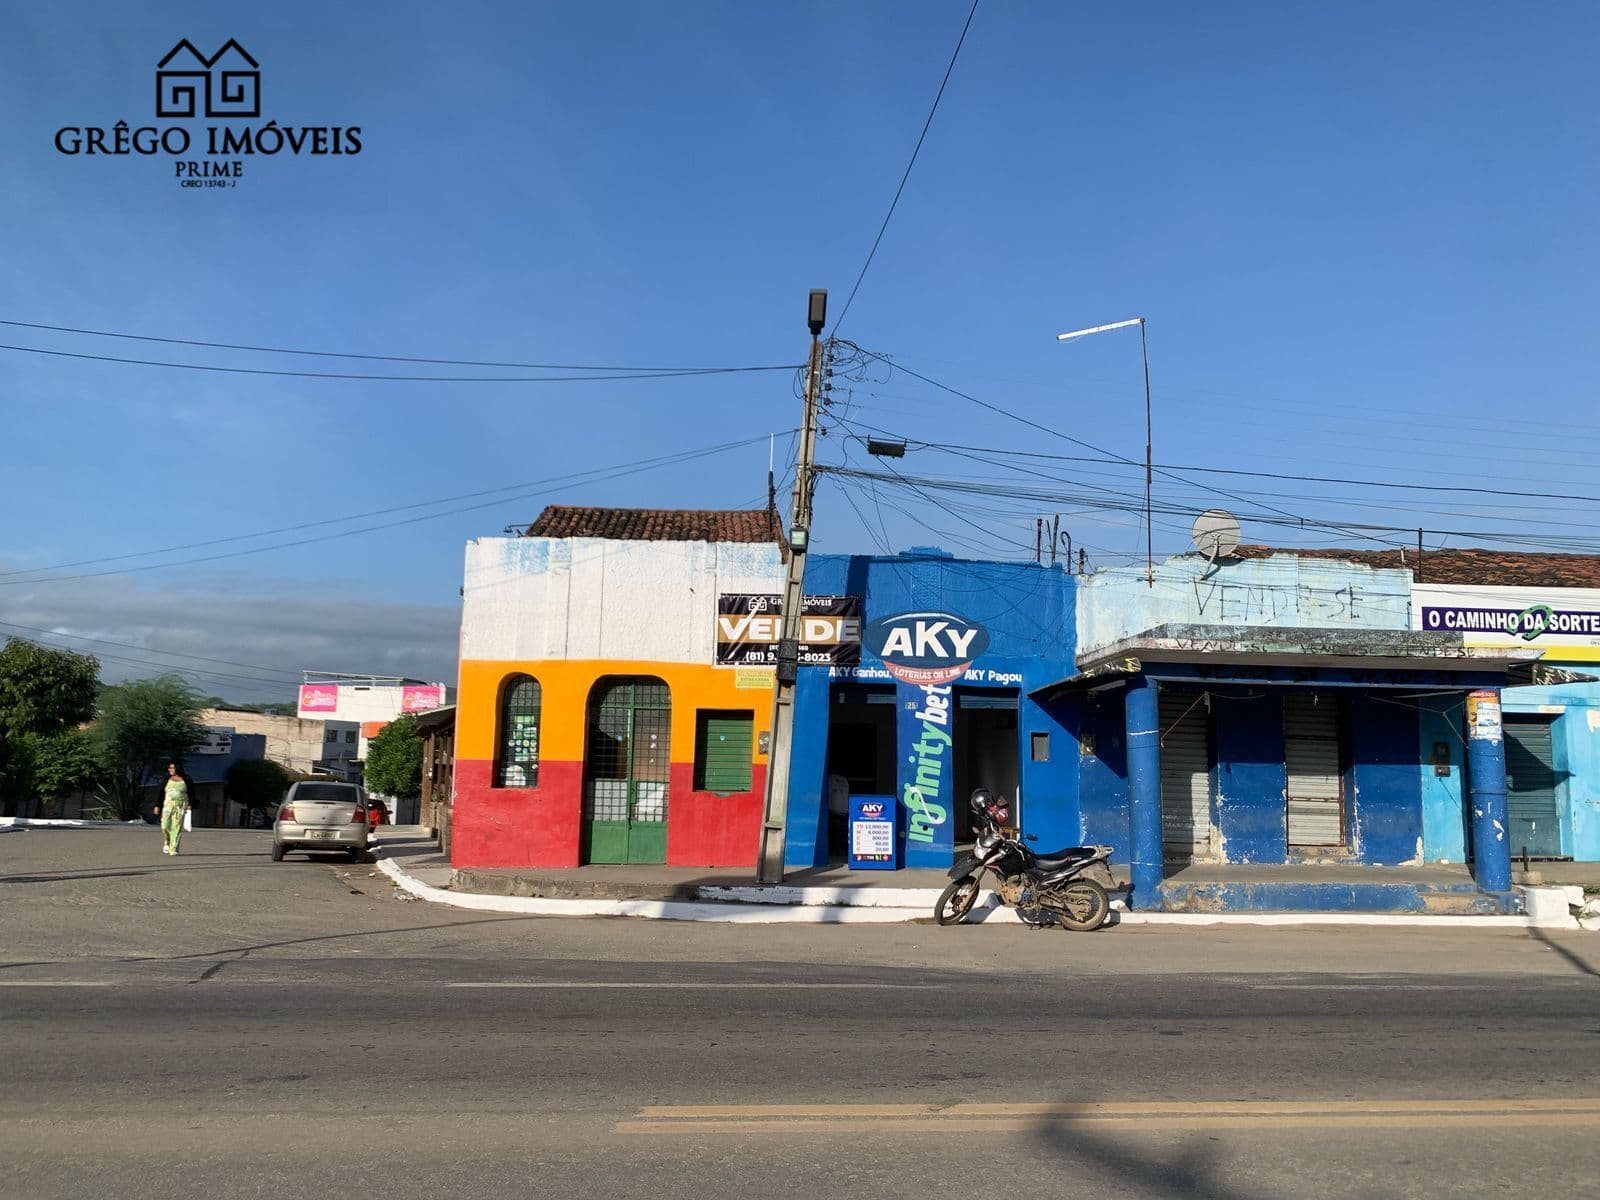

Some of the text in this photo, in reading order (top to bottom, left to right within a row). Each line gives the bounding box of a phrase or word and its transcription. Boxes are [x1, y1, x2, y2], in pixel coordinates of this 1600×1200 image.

[1429, 611, 1600, 632] O CAMINHO DA SORTE
[719, 618, 860, 642] VEDE
[881, 621, 977, 658] AKY
[745, 652, 765, 662] (81)
[829, 666, 850, 678] AKY
[895, 668, 932, 680] LOTERIAS
[964, 669, 1023, 685] AKY Pagou
[862, 804, 884, 812] AKY
